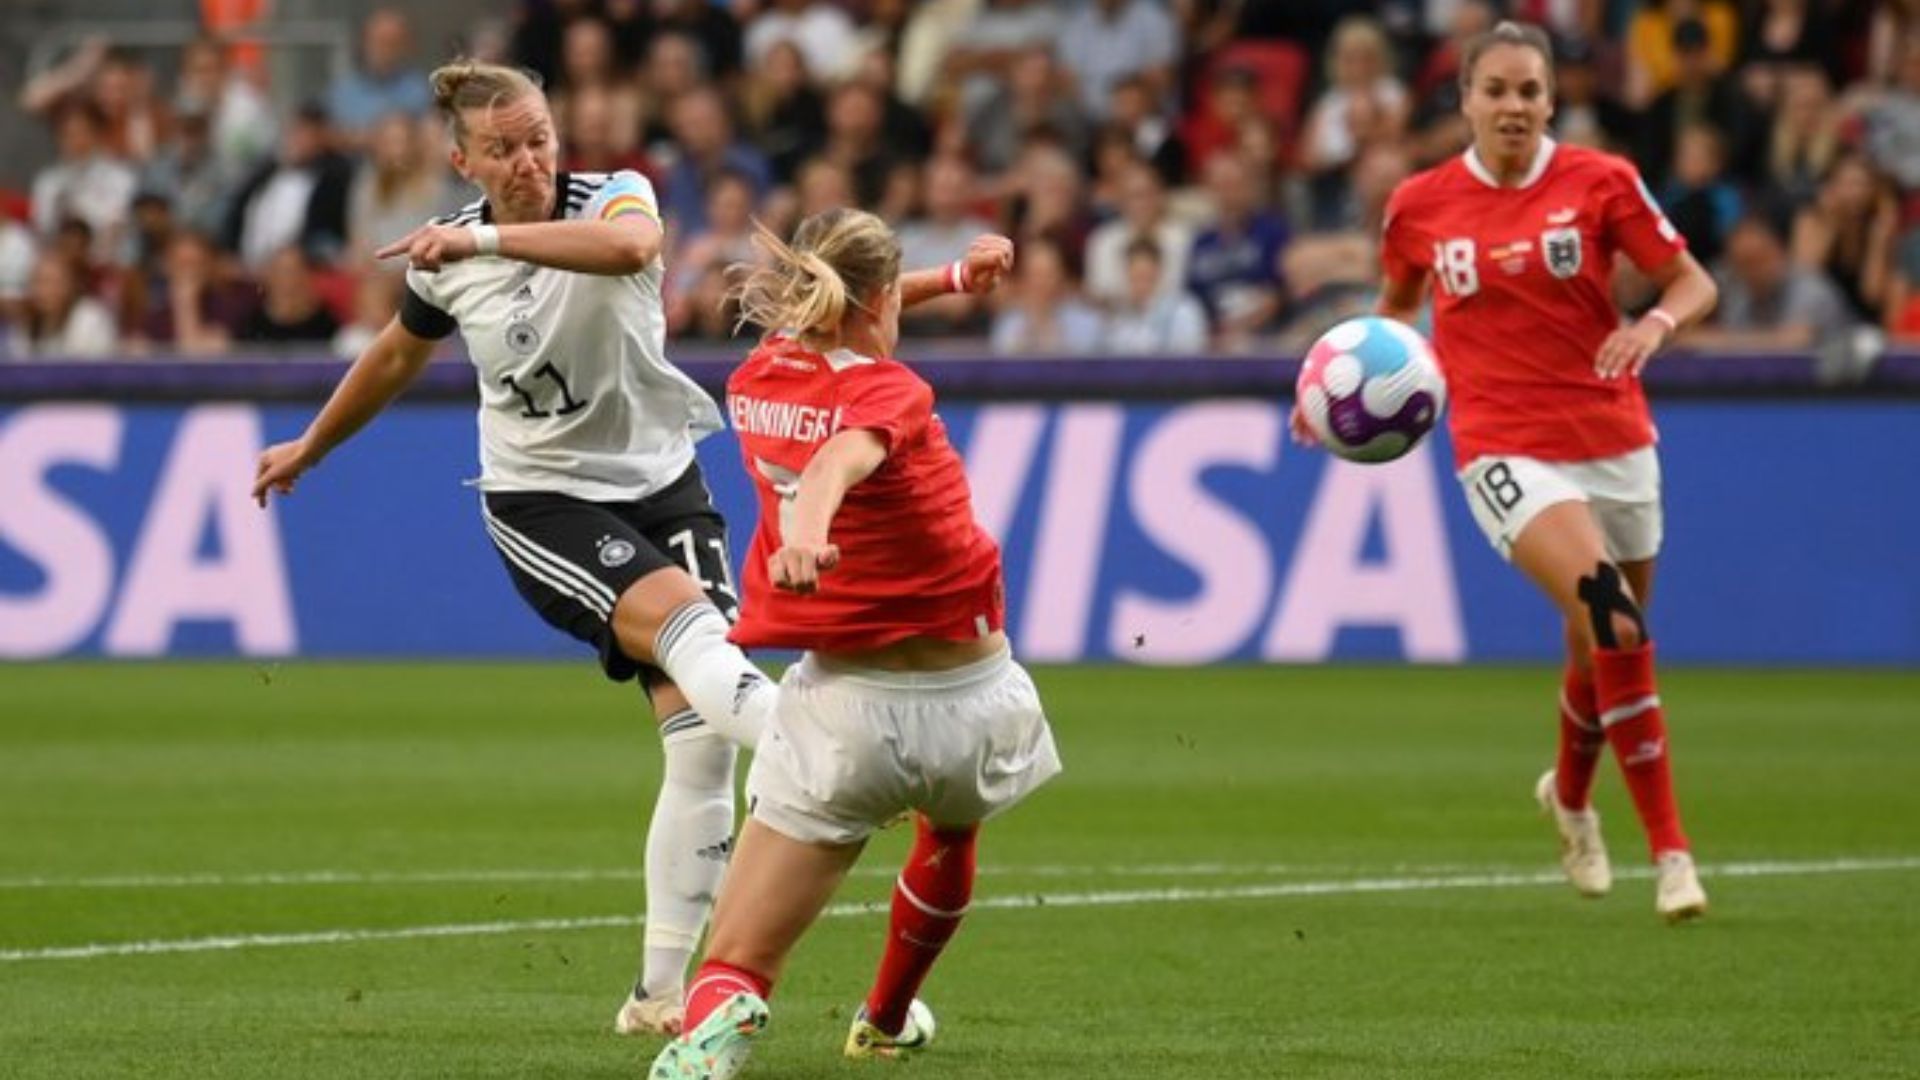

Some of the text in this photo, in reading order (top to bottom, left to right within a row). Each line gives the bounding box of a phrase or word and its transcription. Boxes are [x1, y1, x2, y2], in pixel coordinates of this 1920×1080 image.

[1433, 238, 1480, 297] 18
[501, 361, 588, 419] 11
[728, 394, 843, 443] ENNING
[1475, 461, 1524, 525] 18
[668, 528, 738, 600] 11
